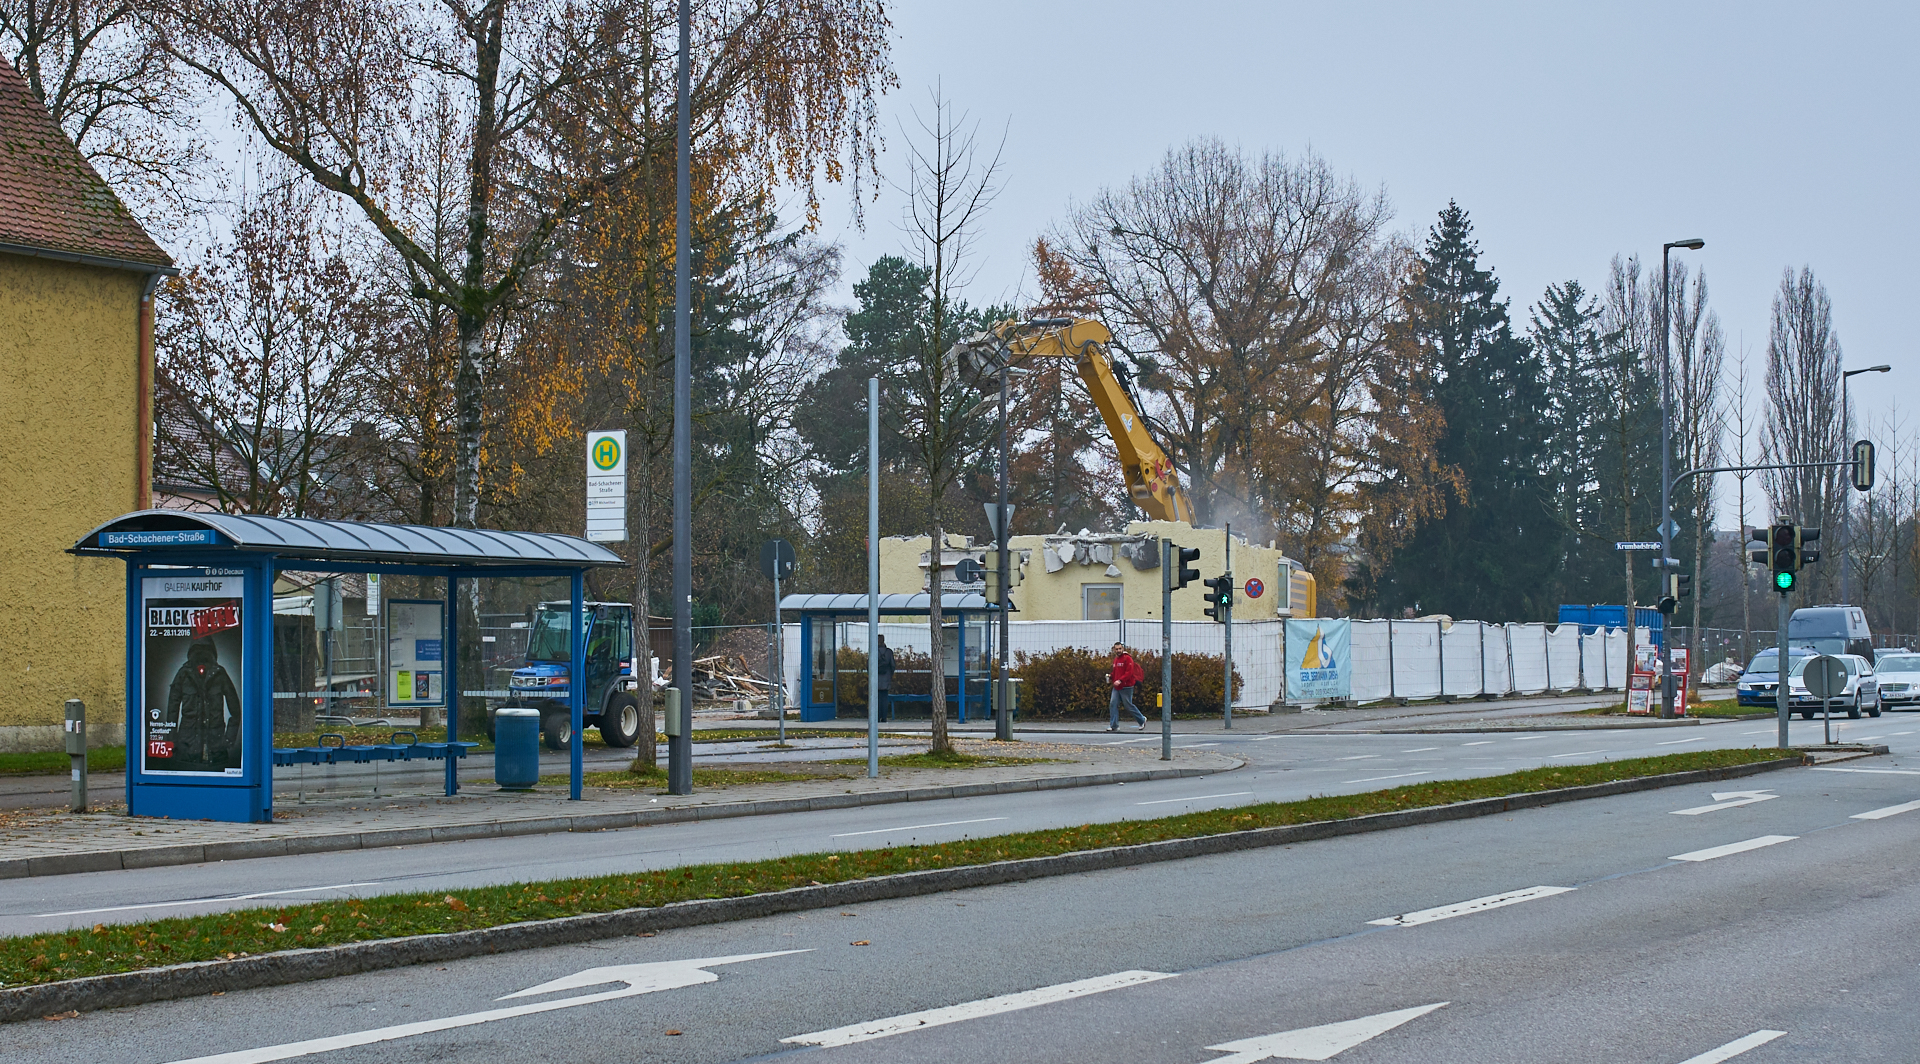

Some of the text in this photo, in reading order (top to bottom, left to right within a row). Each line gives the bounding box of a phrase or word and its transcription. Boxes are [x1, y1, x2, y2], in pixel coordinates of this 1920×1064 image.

[108, 531, 205, 544] Bad-Schachener-Straße
[1617, 543, 1661, 551] Krumbadstraße
[164, 582, 191, 592] GALERIA
[150, 609, 190, 626] BLACK
[149, 629, 159, 637] 22.
[163, 629, 191, 637] 28.11.2016
[150, 742, 172, 756] 175,-
